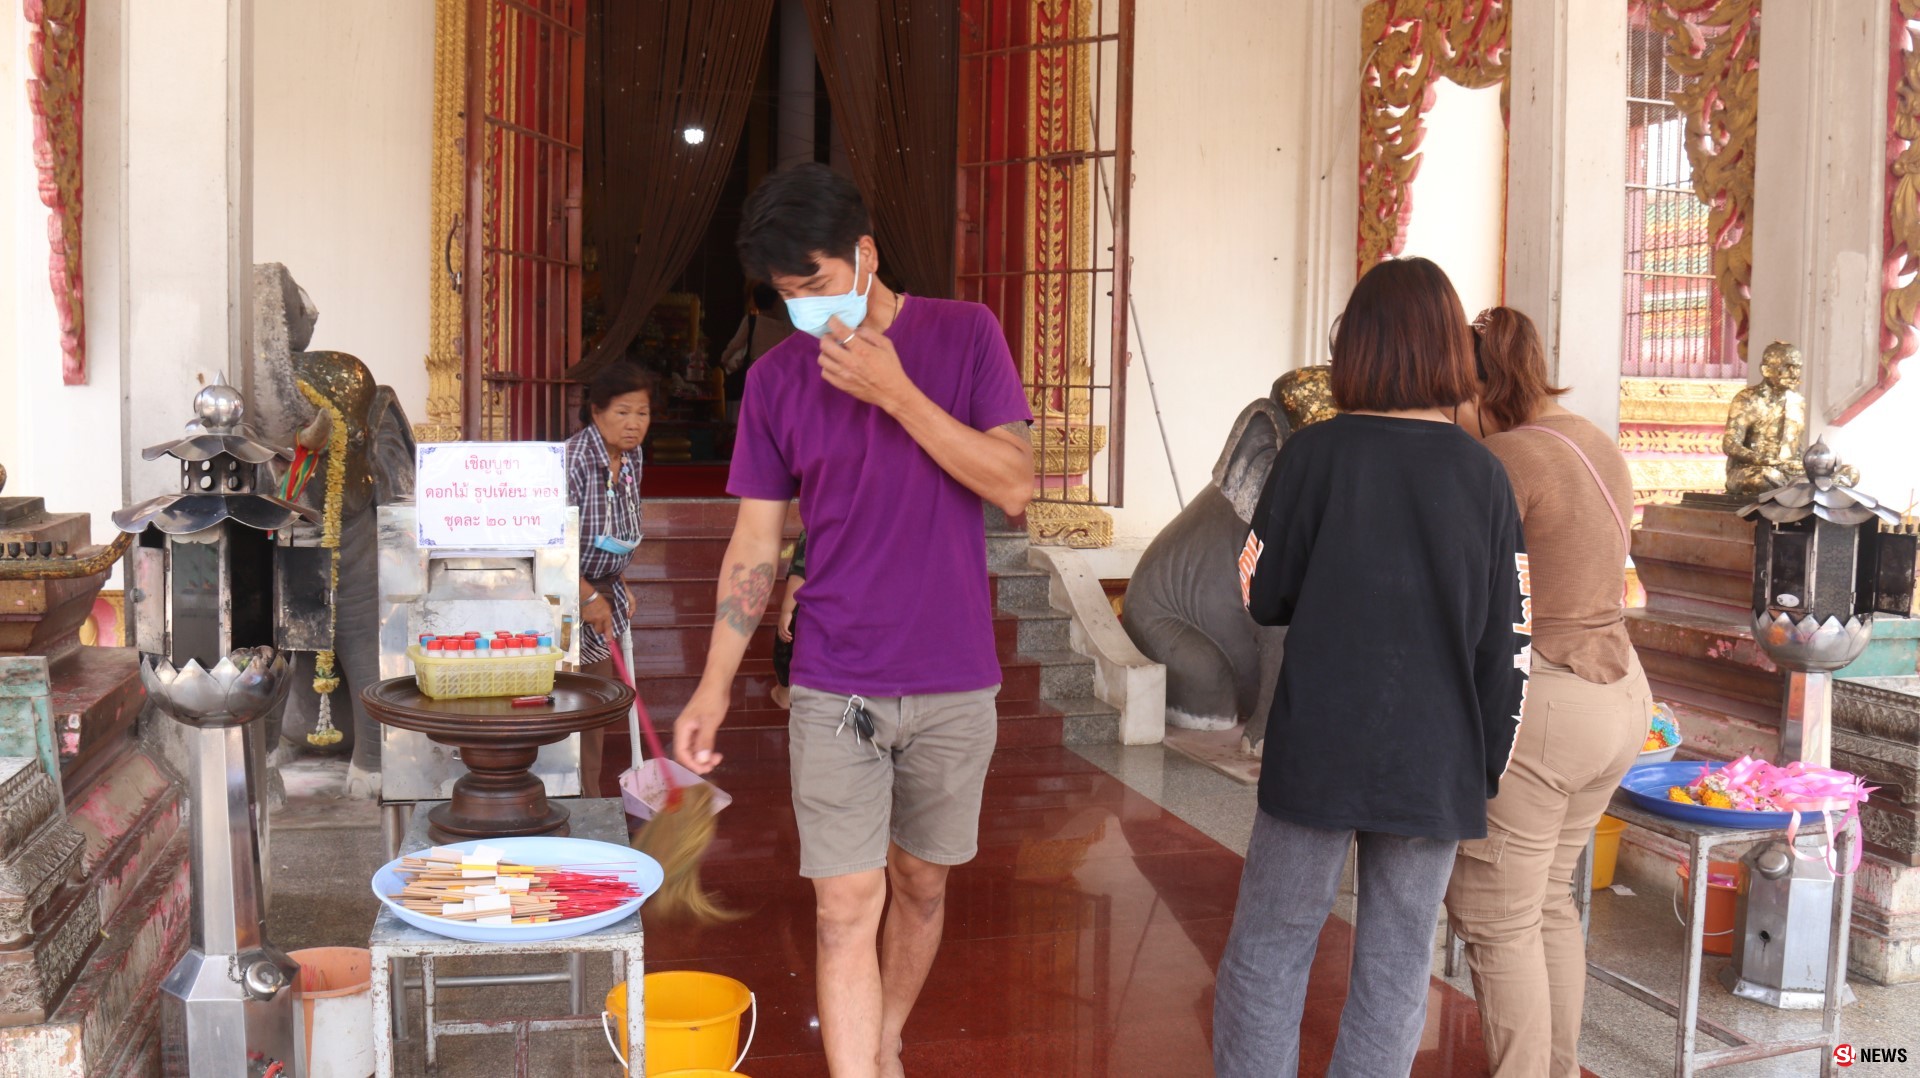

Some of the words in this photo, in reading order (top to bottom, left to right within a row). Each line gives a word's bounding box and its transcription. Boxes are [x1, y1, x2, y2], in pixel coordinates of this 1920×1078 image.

[465, 455, 520, 475] เชิญบูชา
[425, 482, 469, 499] ดอกไม้
[474, 482, 527, 503] ธูปเทียน
[533, 487, 559, 498] ทอง
[444, 515, 480, 531] ชุดละ
[486, 515, 507, 527] ๒๐
[512, 515, 541, 527] บาท
